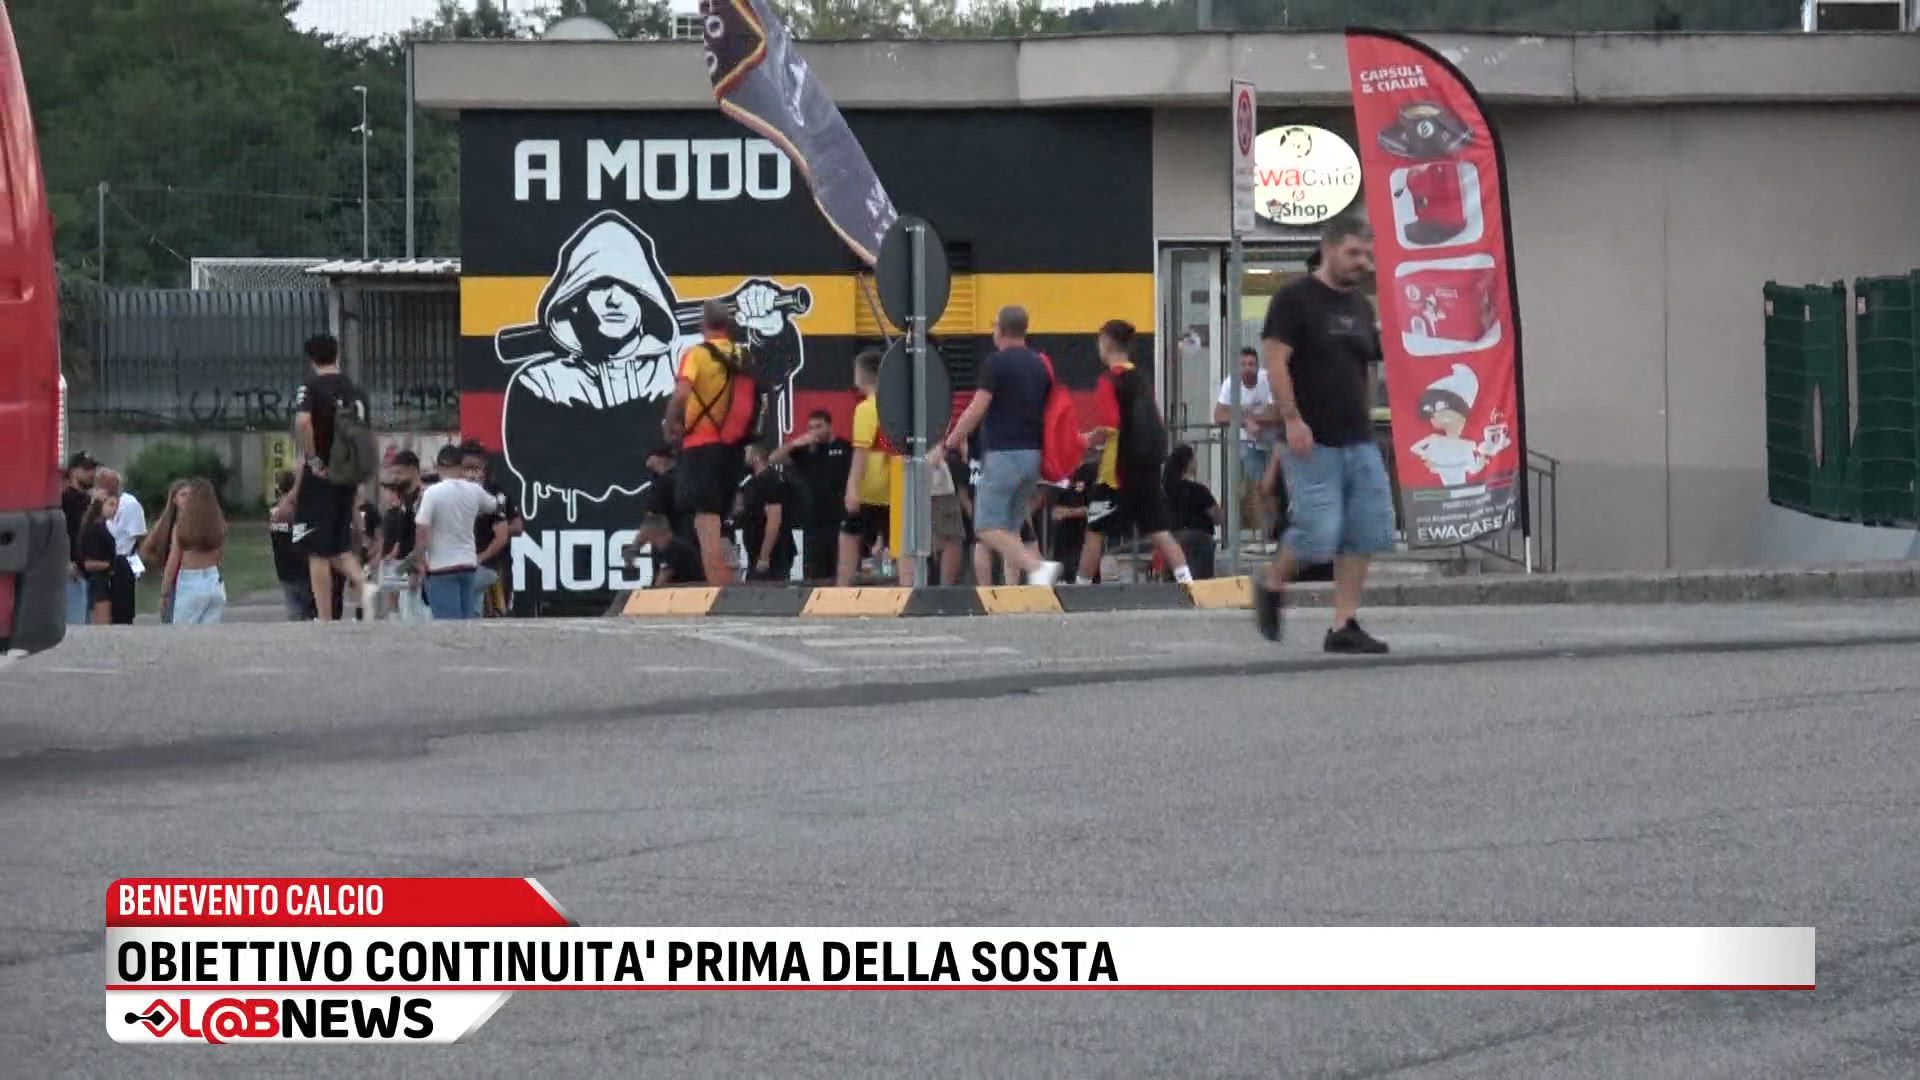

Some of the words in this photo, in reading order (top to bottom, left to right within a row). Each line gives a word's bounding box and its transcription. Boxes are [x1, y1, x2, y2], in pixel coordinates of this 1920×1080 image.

[1360, 64, 1424, 82] CAPSULE
[1362, 83, 1374, 94] &
[1377, 76, 1429, 92] CIALDE
[514, 139, 561, 200] A
[587, 138, 792, 200] MODO
